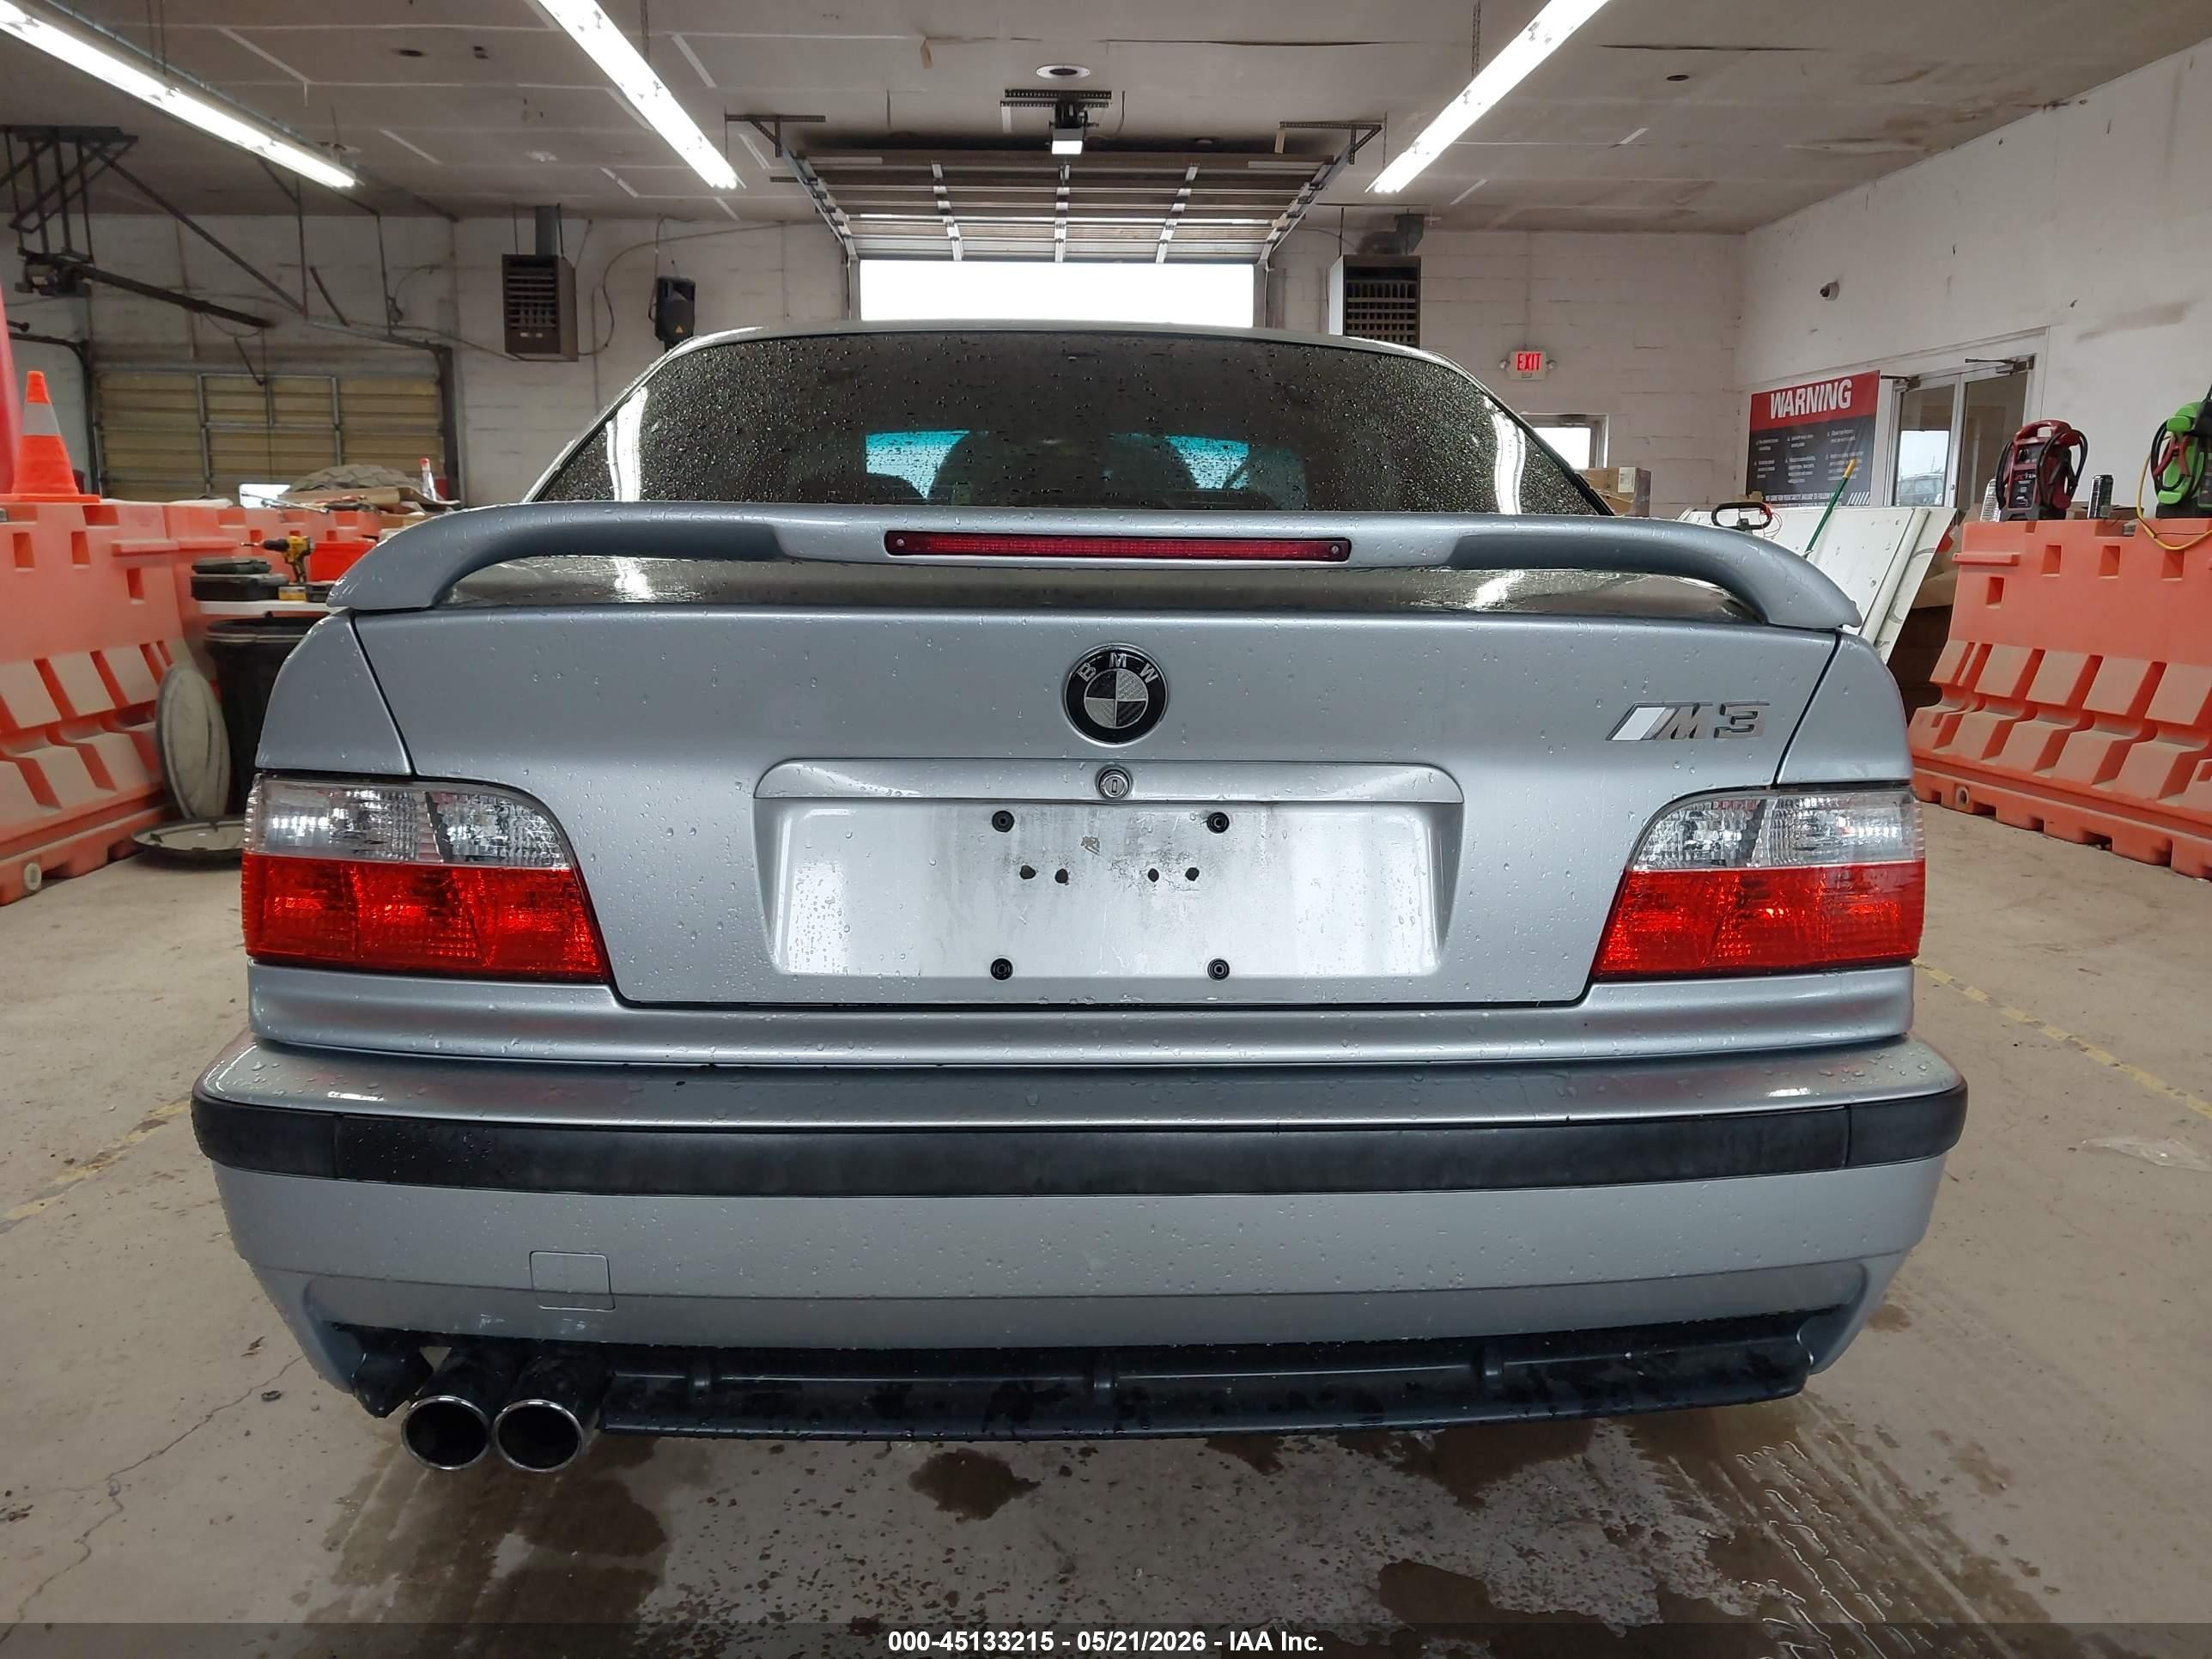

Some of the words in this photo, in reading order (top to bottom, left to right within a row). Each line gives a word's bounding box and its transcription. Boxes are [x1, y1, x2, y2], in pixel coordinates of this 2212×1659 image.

[1516, 353, 1542, 371] EXIT
[1770, 379, 1852, 420] WARNING
[1077, 652, 1159, 684] BMW
[1649, 702, 1770, 741] M3
